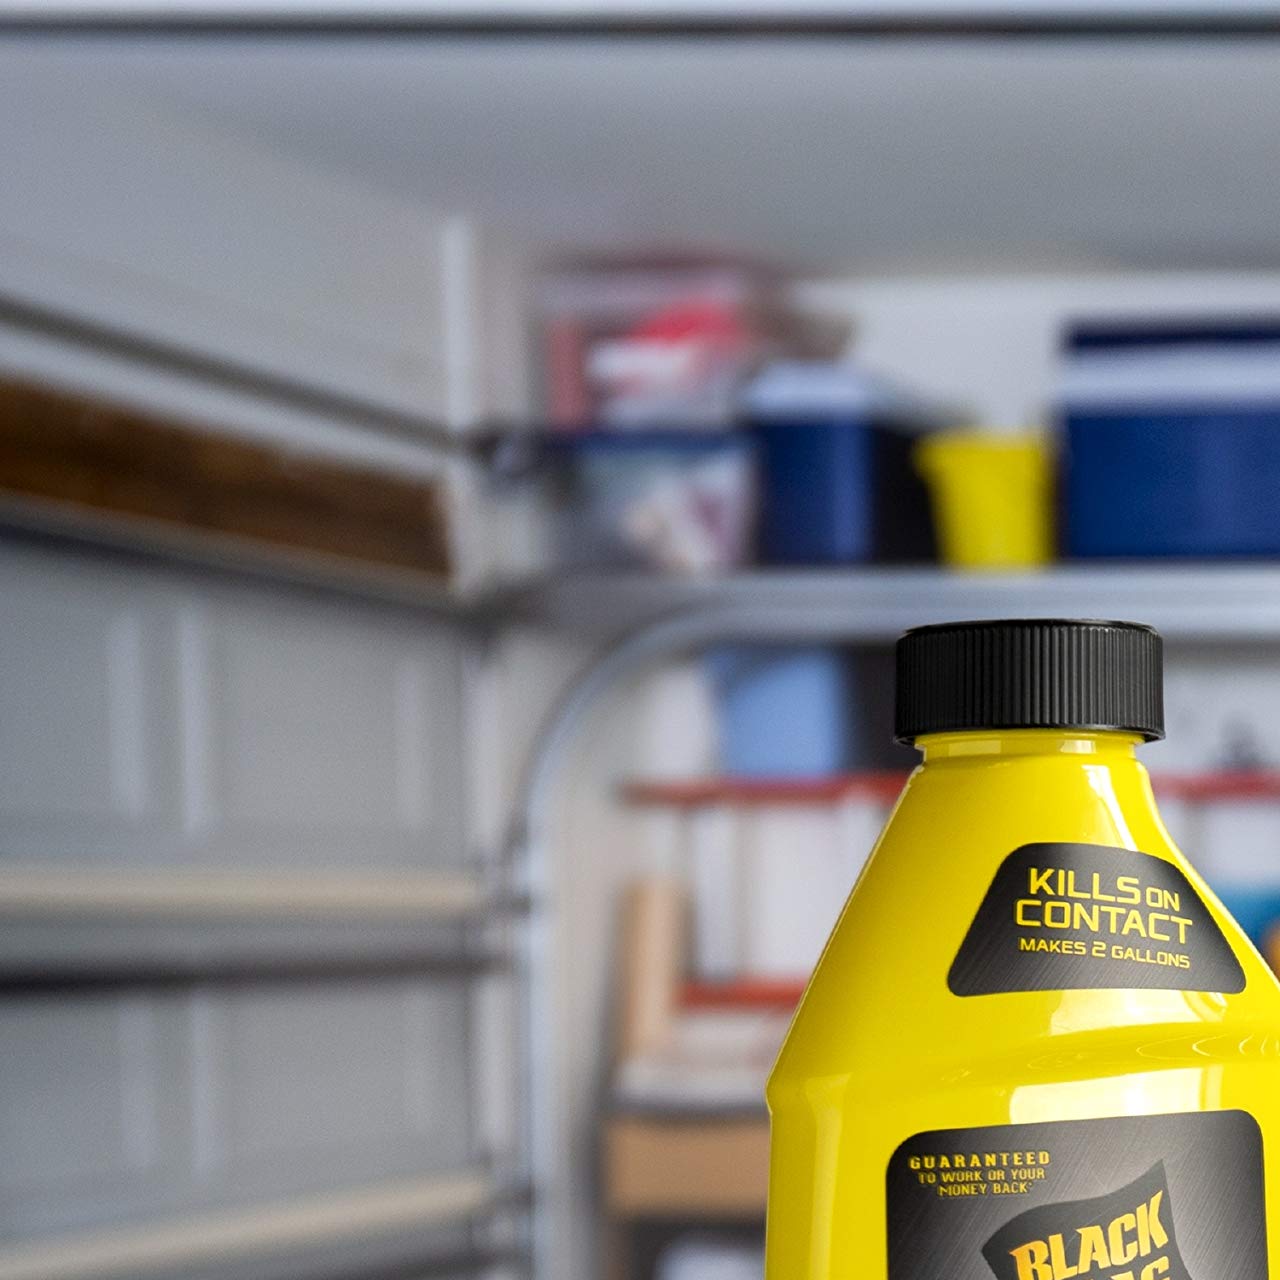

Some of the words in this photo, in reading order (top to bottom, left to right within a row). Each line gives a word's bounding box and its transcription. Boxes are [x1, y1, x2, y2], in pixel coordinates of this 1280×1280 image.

[1029, 868, 1140, 904] KILLS
[1146, 887, 1179, 912] ON
[1016, 900, 1193, 944] CONTACT
[1020, 938, 1086, 956] MAKES
[1092, 941, 1106, 957] 2
[1111, 946, 1190, 969] GALLONS
[910, 1151, 1050, 1170] GUARANTEED
[919, 1172, 936, 1184] TO
[942, 1170, 983, 1182] WORK
[988, 1169, 1005, 1181] OR
[1011, 1168, 1045, 1180] YOUR
[938, 1183, 987, 1196] MONEY
